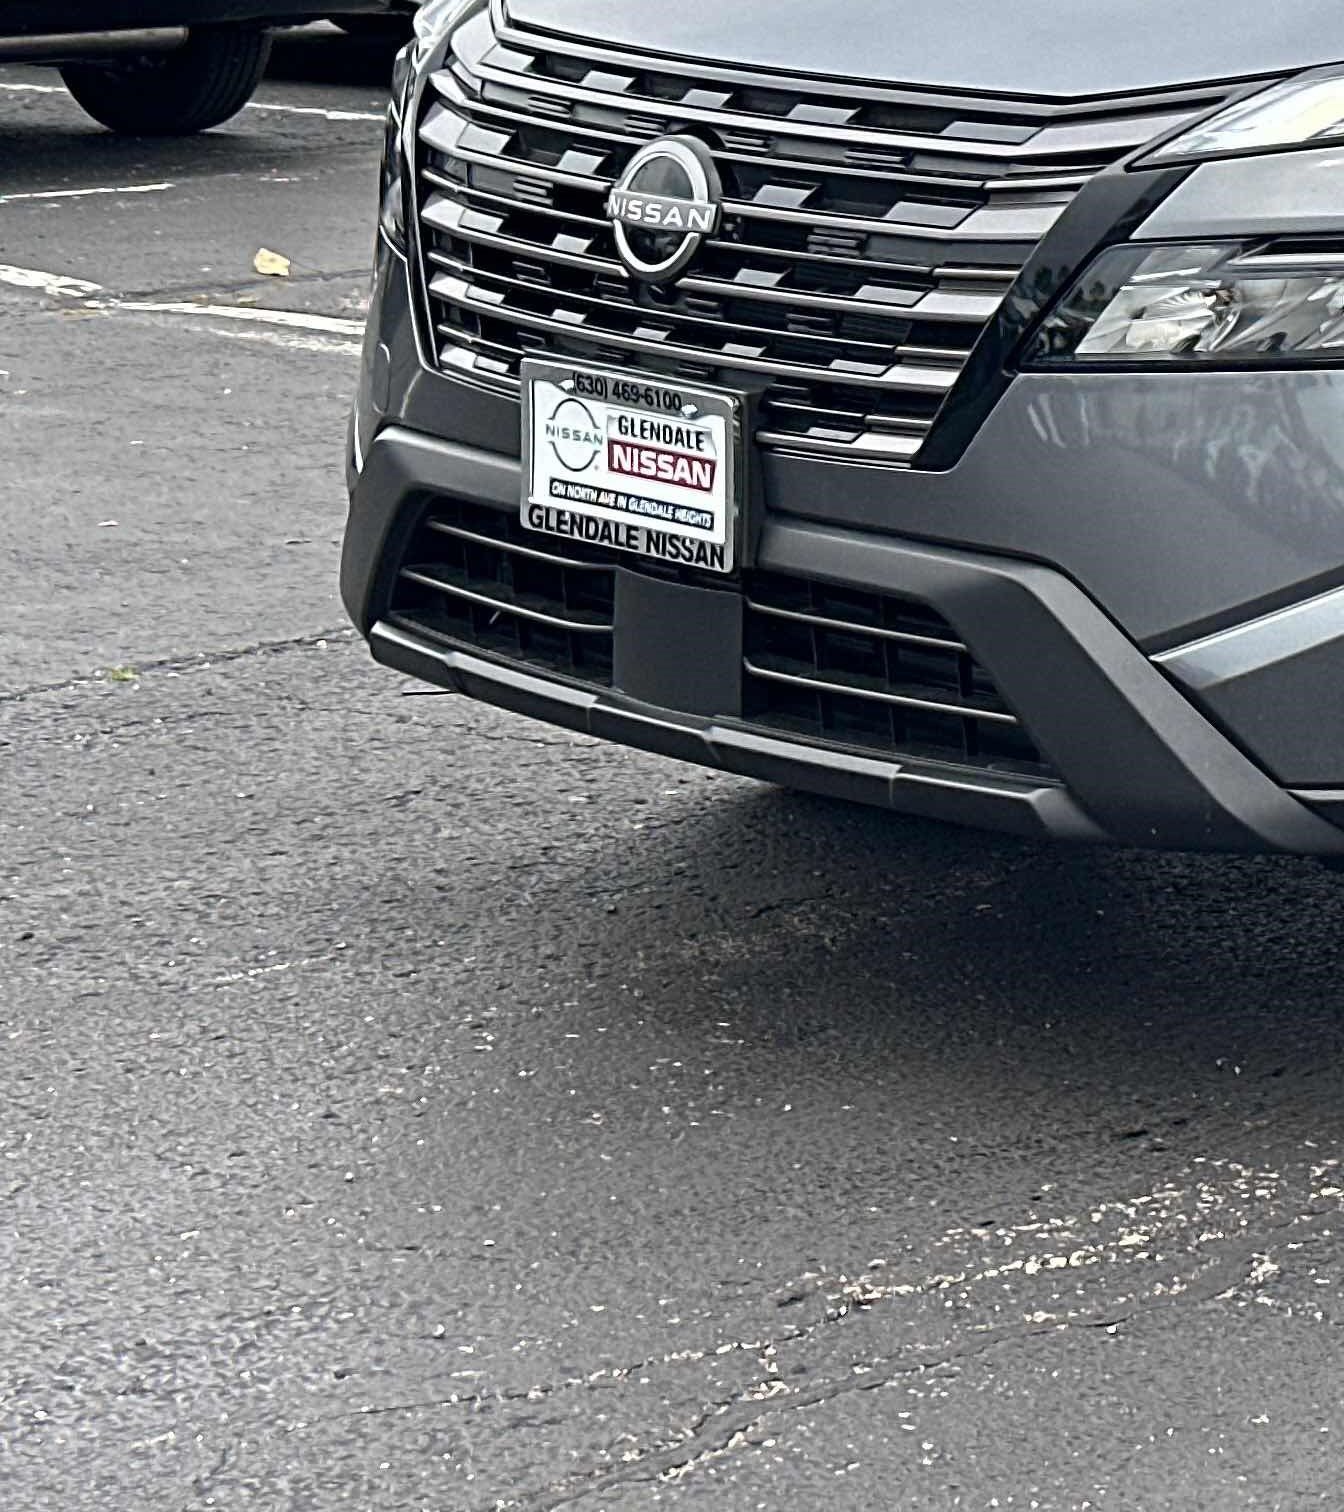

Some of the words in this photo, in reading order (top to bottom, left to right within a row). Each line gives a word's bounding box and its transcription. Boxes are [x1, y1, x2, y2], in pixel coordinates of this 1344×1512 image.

[607, 194, 711, 230] NISSAN
[572, 372, 608, 399] (630)
[545, 422, 603, 446] NISSAN
[617, 415, 706, 452] GLENDALE
[611, 444, 712, 489] NISSAN
[551, 481, 567, 496] ON
[598, 491, 617, 507] AVE
[617, 494, 628, 509] IN
[628, 497, 674, 520] GLENDALE
[528, 505, 641, 550] GLENDALE
[645, 530, 725, 570] NISSAN
